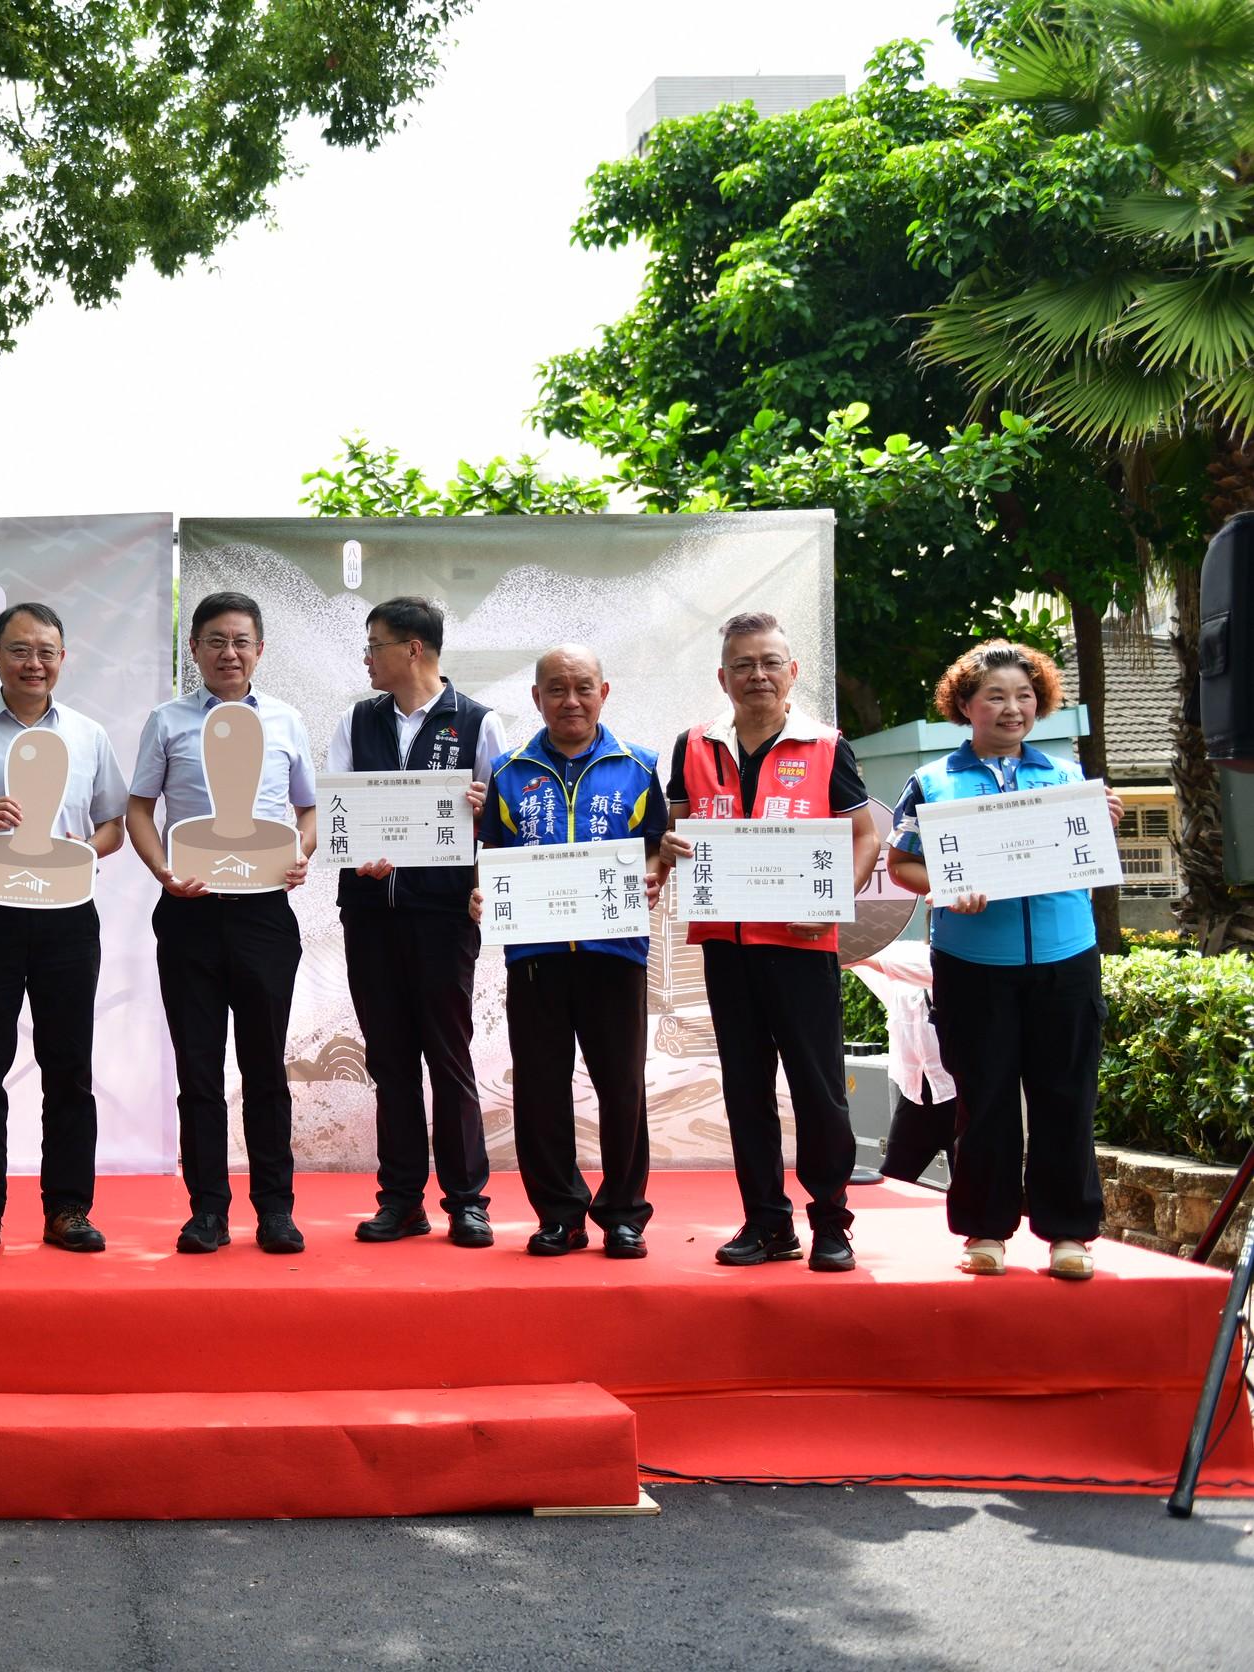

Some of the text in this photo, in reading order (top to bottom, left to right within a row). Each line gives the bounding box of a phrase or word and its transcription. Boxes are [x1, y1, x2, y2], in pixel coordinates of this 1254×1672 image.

[329, 794, 349, 854] 久良栖
[436, 799, 455, 845] 豐原
[542, 787, 557, 835] 立法委員
[610, 790, 624, 815] 主任
[712, 794, 734, 819] 何
[939, 833, 964, 883] 白岩
[1064, 816, 1096, 866] 旭丘
[599, 868, 619, 921] 貯木池
[623, 874, 642, 910] 豐原
[692, 841, 713, 906] 佳保臺
[811, 850, 833, 899] 黎明
[492, 875, 512, 921] 石岡
